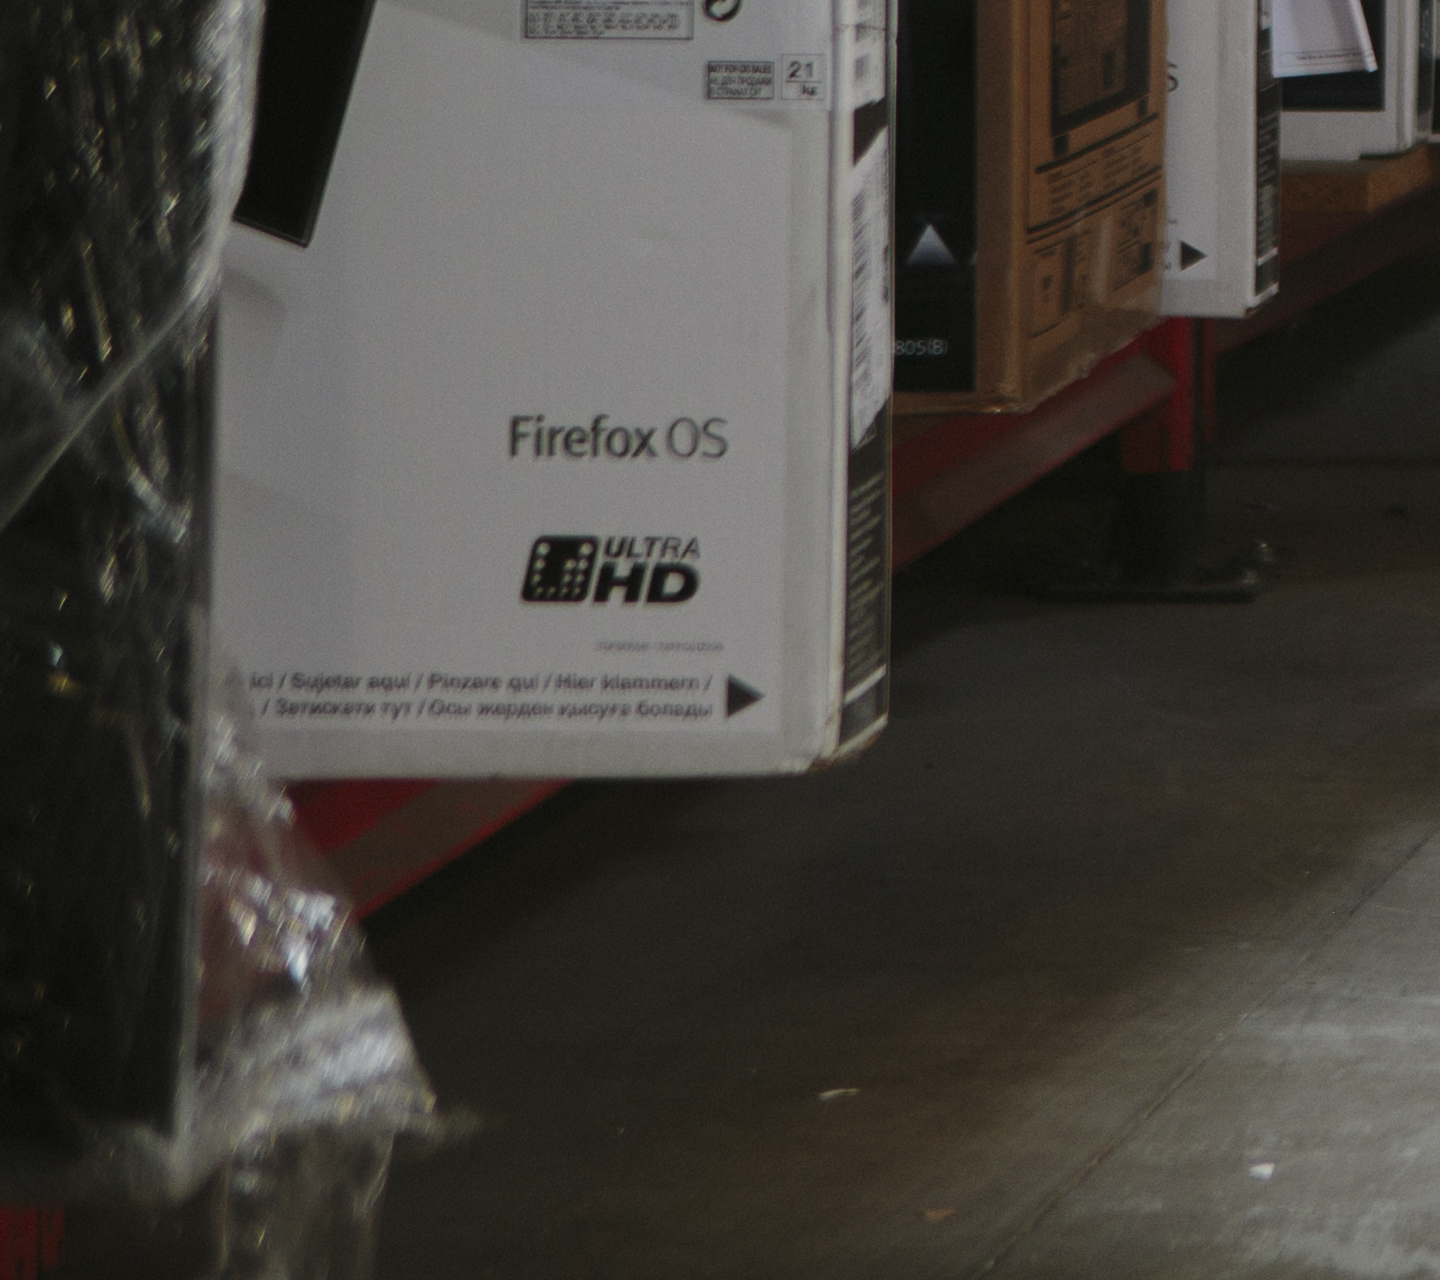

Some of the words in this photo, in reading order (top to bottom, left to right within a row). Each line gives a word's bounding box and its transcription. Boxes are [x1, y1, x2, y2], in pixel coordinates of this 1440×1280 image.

[787, 60, 814, 78] 21
[508, 413, 660, 459] Firefox
[665, 416, 729, 459] OS
[603, 536, 701, 559] ULTRA
[592, 561, 701, 604] HD
[249, 672, 273, 690] ici
[291, 671, 363, 697] Sujetar
[427, 672, 502, 691] Pinzare
[506, 673, 539, 694] qui
[557, 673, 597, 690] Hier
[601, 673, 701, 691] klammern
[275, 698, 376, 716] Затискати
[380, 700, 413, 721] тут
[428, 698, 471, 717] Осы
[635, 699, 713, 718] болады
